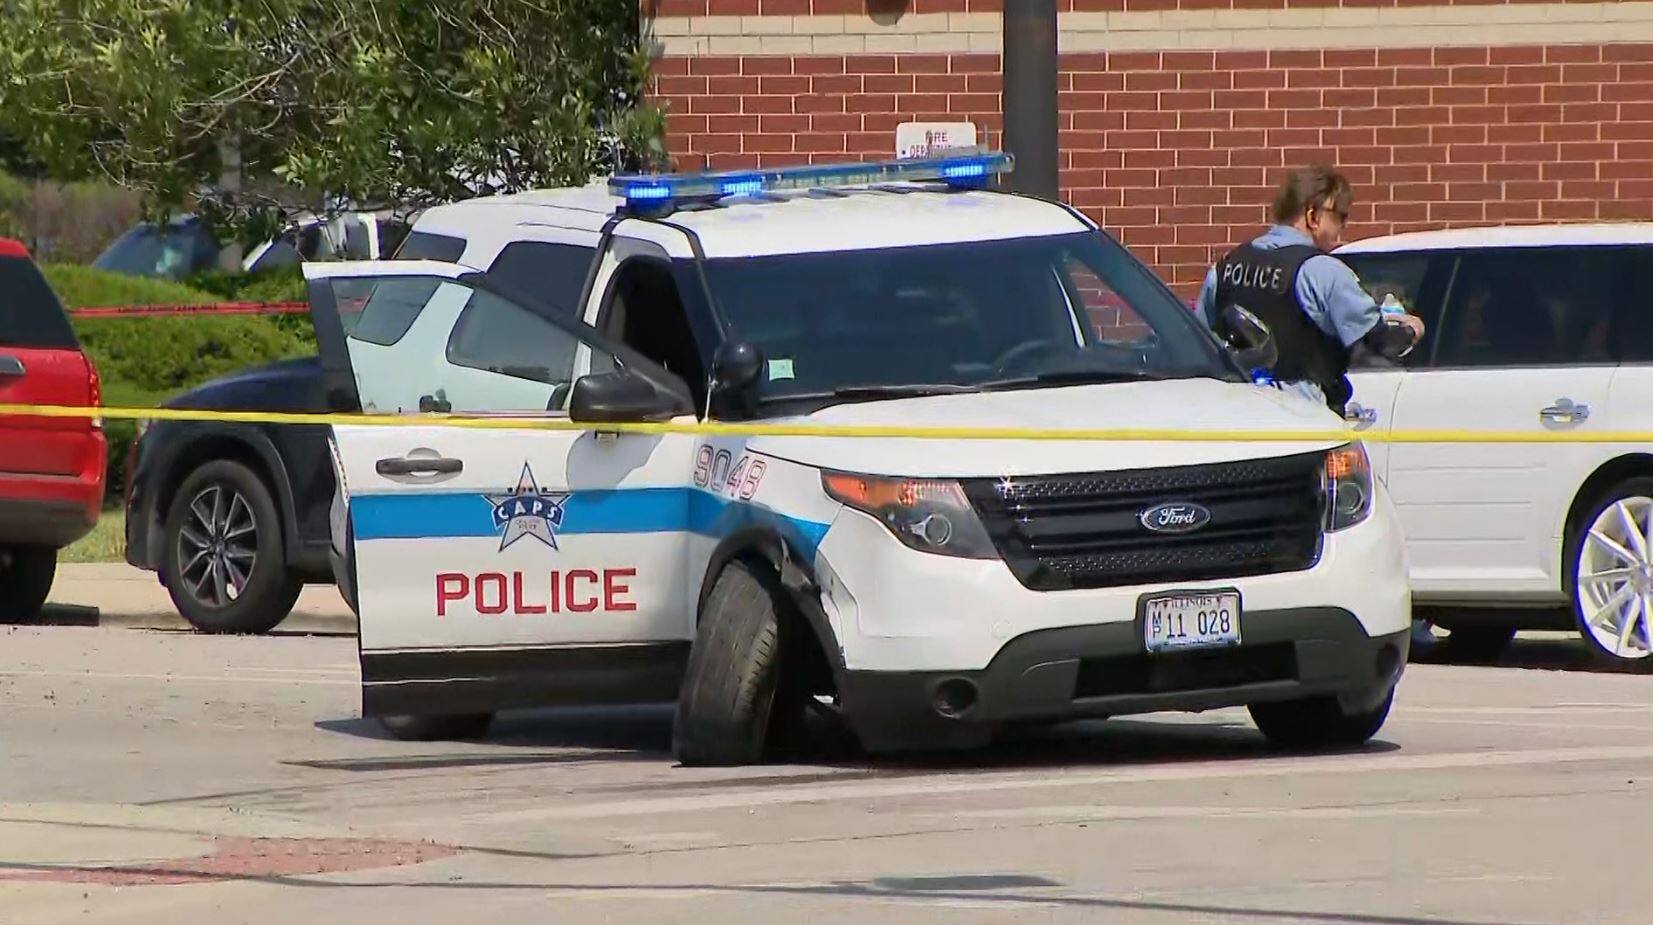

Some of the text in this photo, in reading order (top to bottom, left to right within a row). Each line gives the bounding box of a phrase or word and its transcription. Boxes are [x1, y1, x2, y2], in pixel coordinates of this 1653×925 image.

[1223, 263, 1282, 289] POLICE
[694, 444, 767, 501] 9048
[497, 500, 558, 519] CAPS
[1158, 507, 1196, 525] Ford
[436, 568, 637, 616] POLICE
[1167, 613, 1187, 638] 11
[1198, 609, 1230, 635] 028
